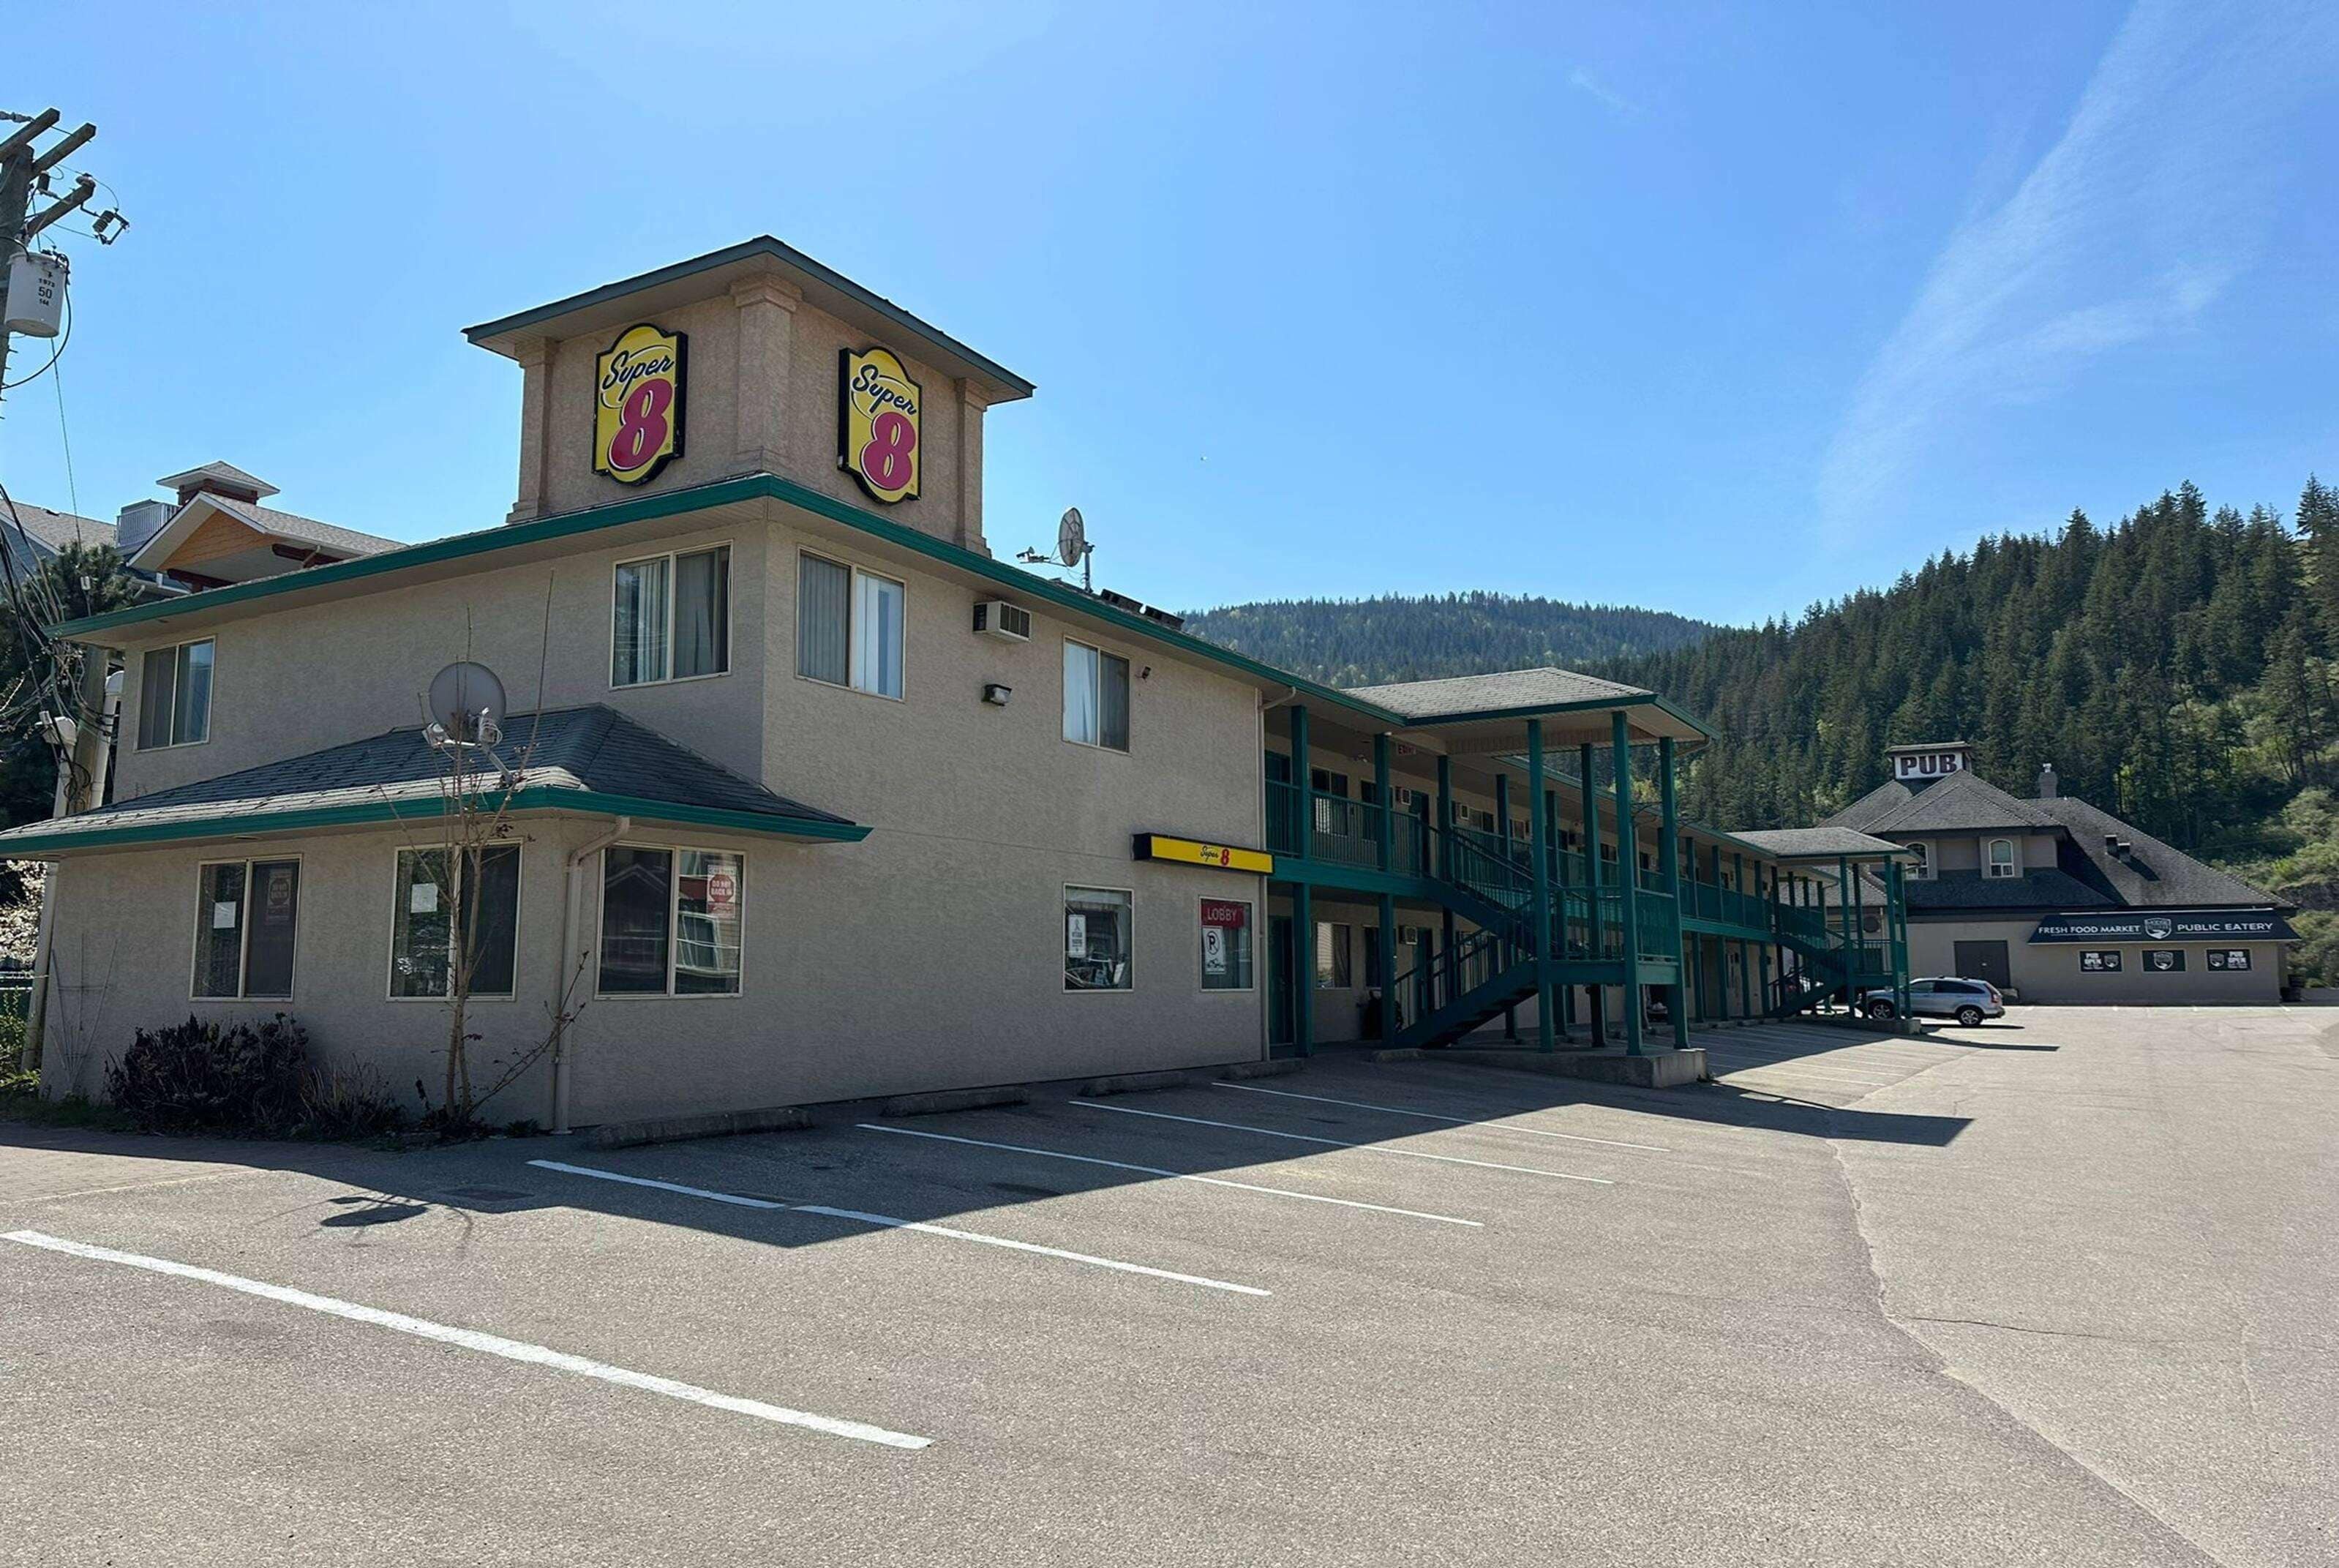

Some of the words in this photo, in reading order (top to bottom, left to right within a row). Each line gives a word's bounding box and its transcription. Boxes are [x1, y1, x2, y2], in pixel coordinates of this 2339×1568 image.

[38, 286, 52, 299] 50
[602, 349, 675, 402] Super
[852, 364, 917, 416] Super
[607, 378, 673, 471] 8
[860, 411, 917, 491] 8
[1901, 754, 1957, 776] PUB
[1200, 845, 1219, 862] Super
[1220, 849, 1230, 866] 8
[1207, 908, 1238, 921] LOBBY
[2070, 926, 2098, 934] FOOD
[2100, 925, 2141, 933] MARKET
[2177, 923, 2220, 931] PUBLIC
[2225, 922, 2273, 931] EATERY
